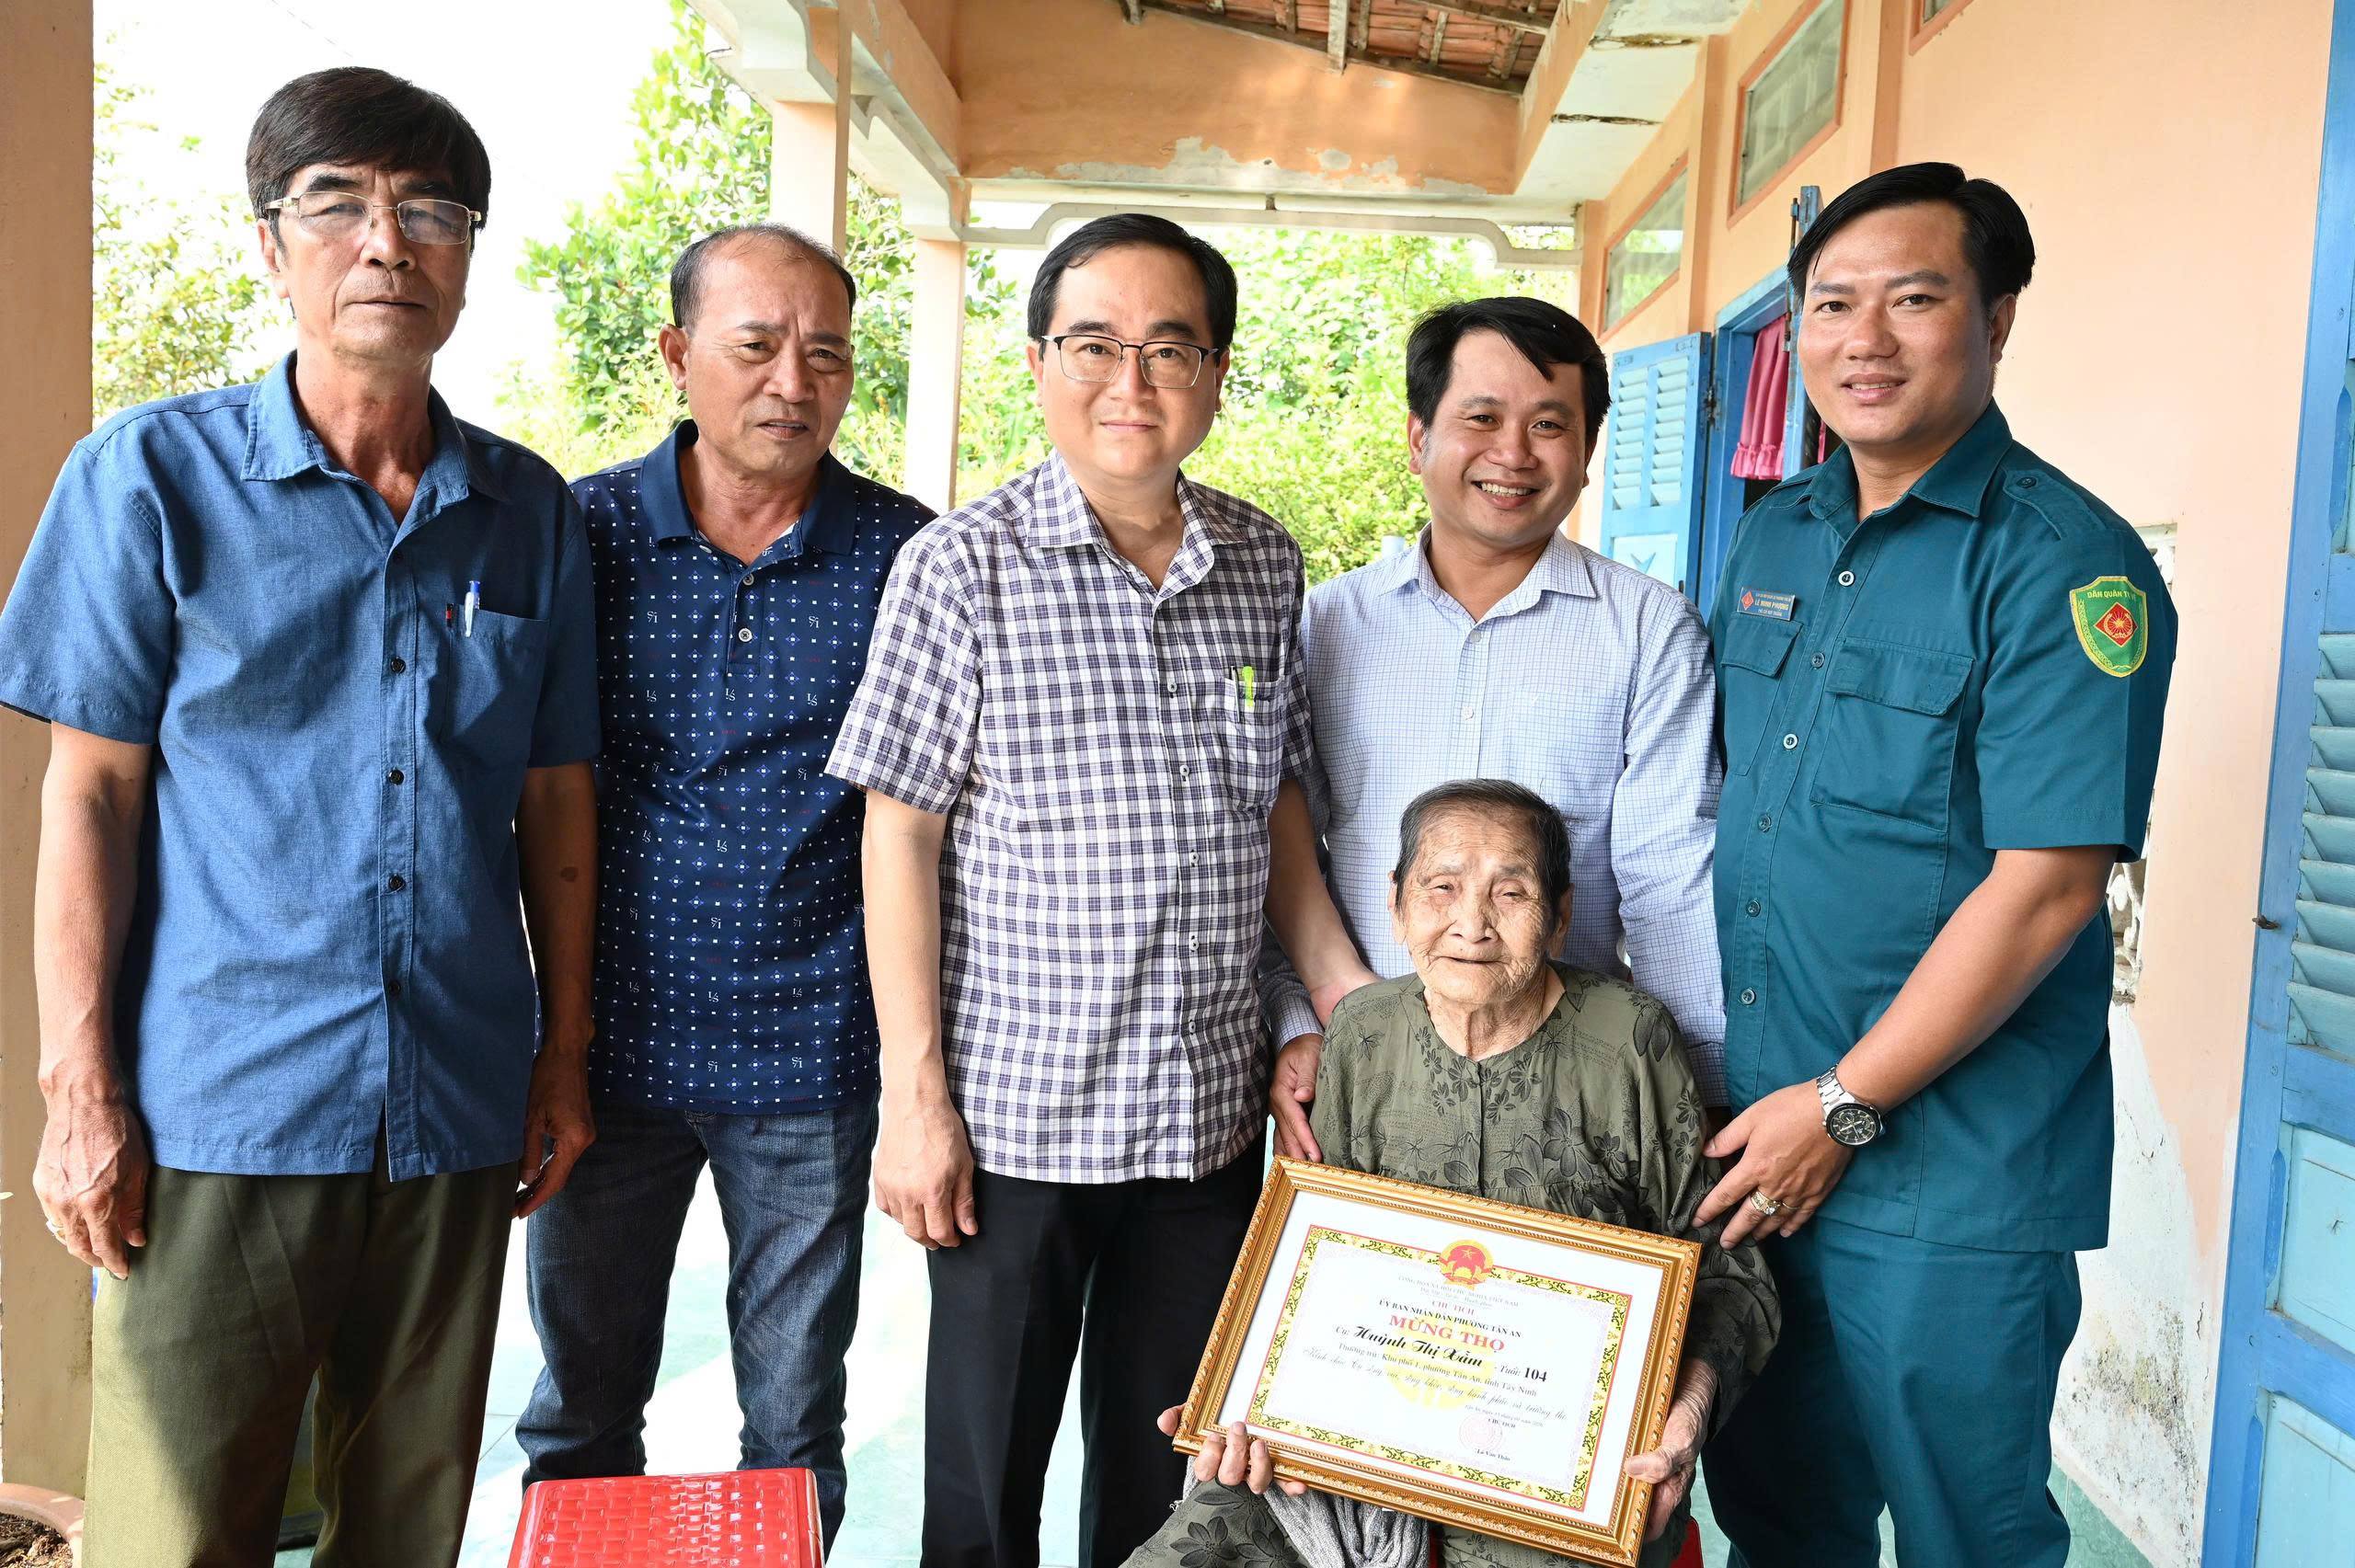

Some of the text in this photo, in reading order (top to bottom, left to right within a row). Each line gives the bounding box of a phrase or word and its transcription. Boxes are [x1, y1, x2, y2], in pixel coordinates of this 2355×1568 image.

[2104, 589, 2122, 598] QUÂN
[1390, 1315, 1504, 1353] MỪNG THỌ
[1392, 1300, 1408, 1311] BAN
[1511, 1328, 1522, 1338] AN
[1354, 1326, 1407, 1348] Huỳnh
[1411, 1340, 1441, 1358] Thị
[1525, 1368, 1546, 1381] 104
[1382, 1353, 1396, 1362] Khu
[1518, 1385, 1537, 1396] Ninh
